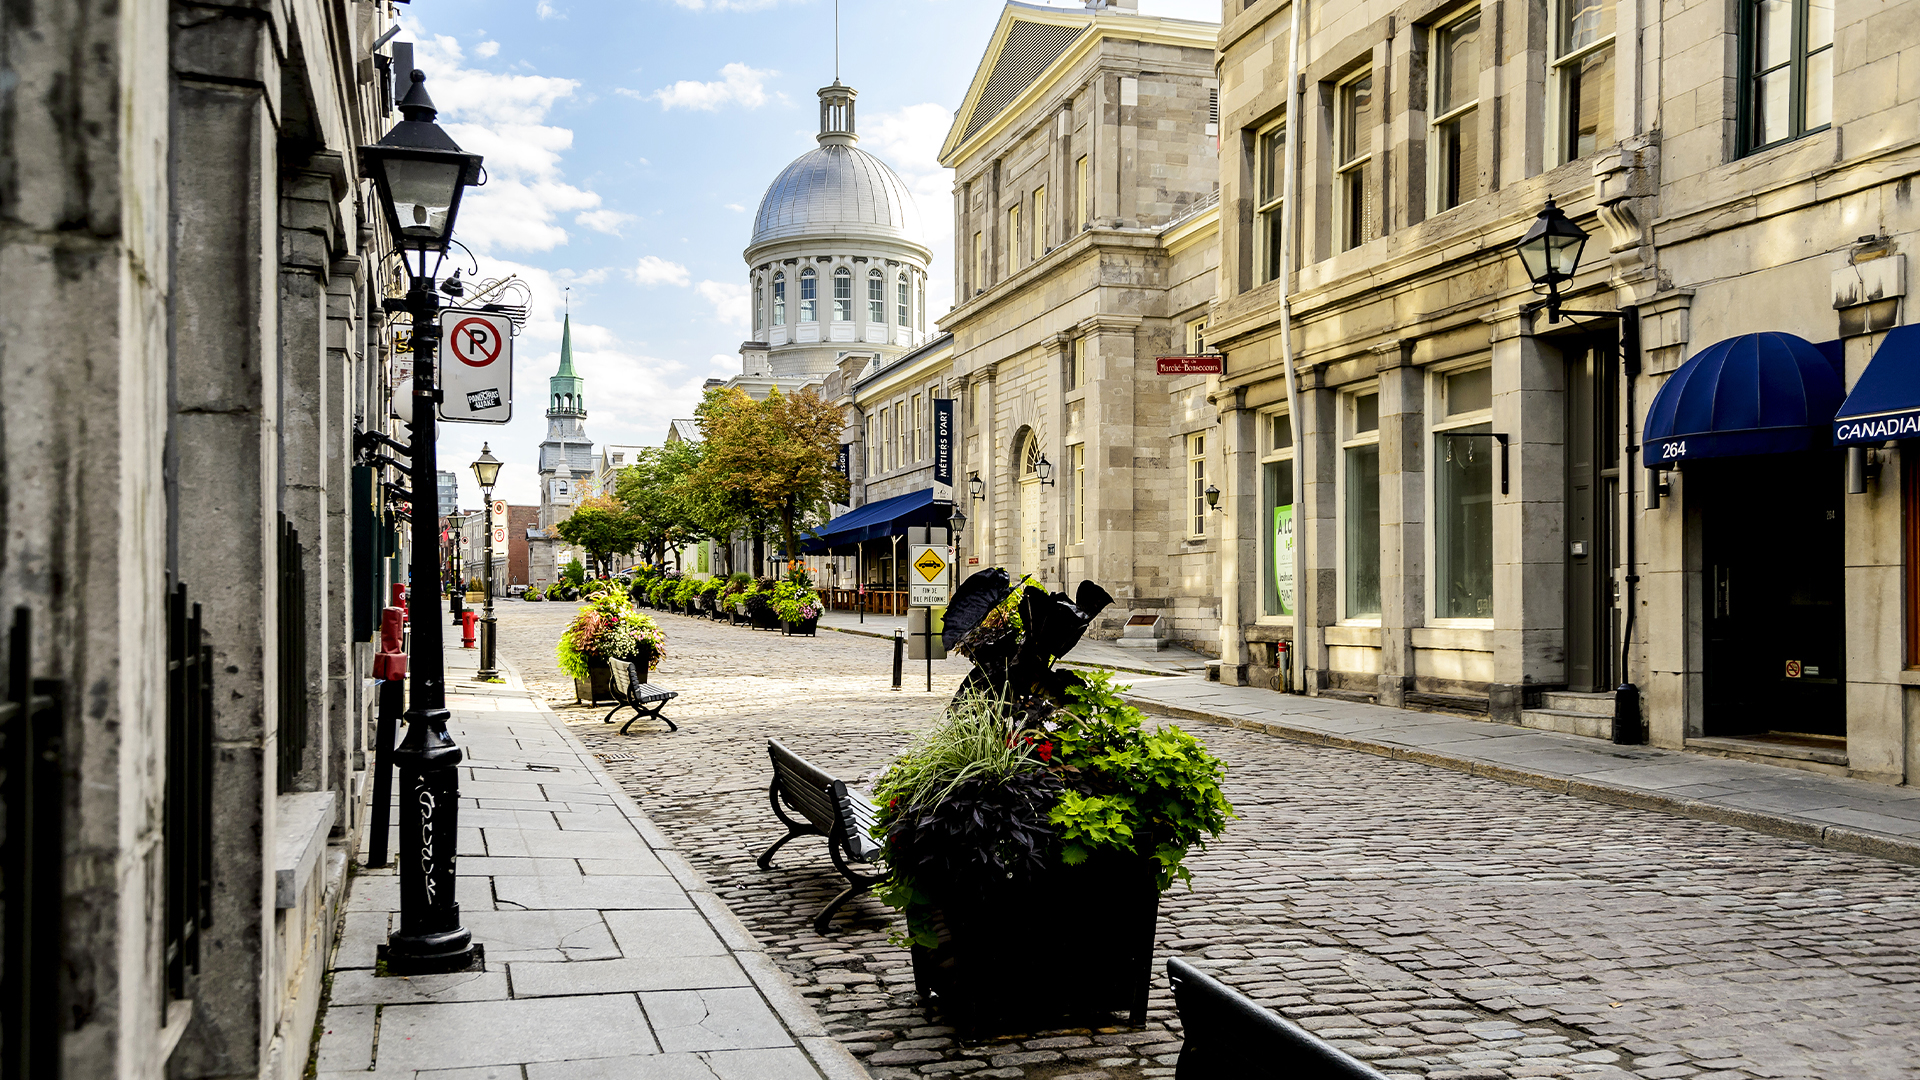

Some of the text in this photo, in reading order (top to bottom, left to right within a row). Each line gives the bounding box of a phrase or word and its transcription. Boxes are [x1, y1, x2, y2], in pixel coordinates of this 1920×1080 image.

[1837, 415, 1920, 440] CANADIA
[939, 410, 948, 477] MÉTIERS D'ART
[1662, 440, 1687, 459] 264
